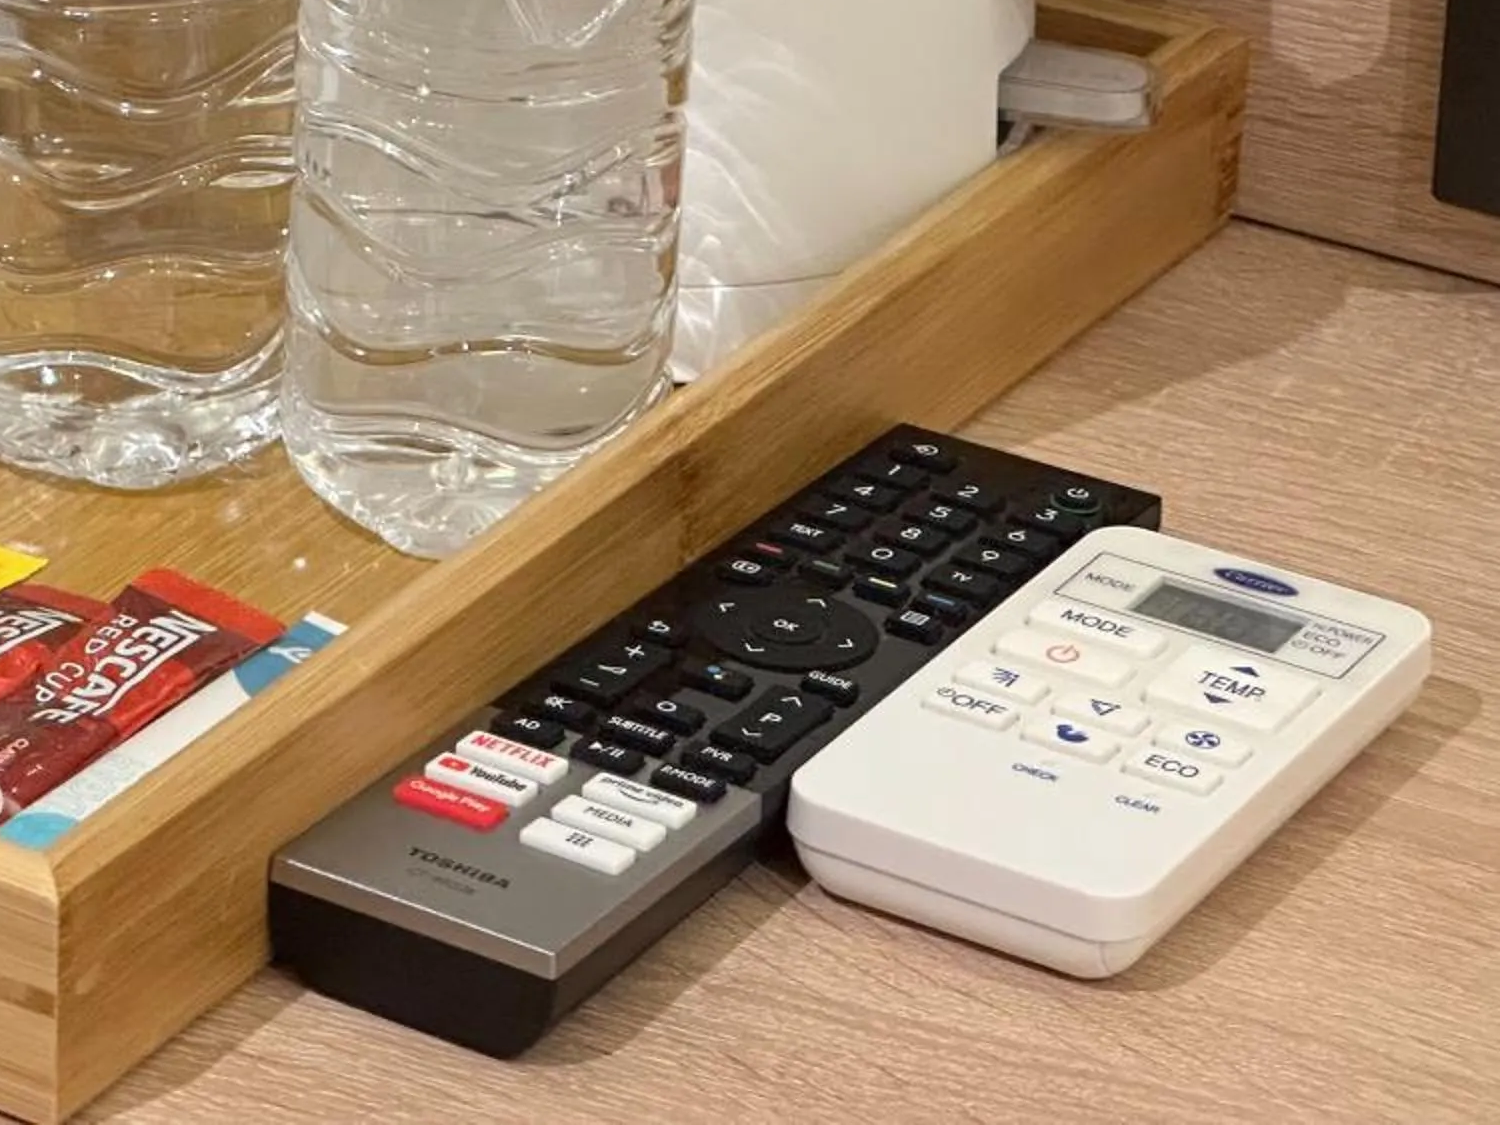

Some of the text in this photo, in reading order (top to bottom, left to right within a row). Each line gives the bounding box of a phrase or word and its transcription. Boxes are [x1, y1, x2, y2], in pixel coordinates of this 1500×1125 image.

[887, 464, 902, 477] 1
[853, 483, 876, 497] 4
[956, 485, 980, 499] 2
[825, 503, 848, 516] 7
[929, 506, 953, 520] 5
[1036, 508, 1059, 522] 3
[790, 523, 825, 539] TEXT
[900, 526, 923, 540] 8
[1008, 528, 1027, 543] 6
[981, 549, 1000, 563] 9
[1084, 572, 1139, 593] MODE
[772, 618, 800, 633] OK
[1061, 608, 1135, 639] MODE
[83, 613, 140, 655] RED
[1302, 630, 1341, 647] ECO
[1309, 644, 1346, 659] OFF
[34, 661, 85, 703] CUP
[808, 669, 853, 691] GUIDE
[950, 693, 1010, 715] OFF
[513, 717, 541, 731] AD
[759, 712, 784, 725] P
[606, 715, 669, 740] SUBTITLE
[470, 733, 557, 769] NETFLIX
[700, 746, 733, 762] PVR
[1010, 762, 1060, 783] CHECK
[1143, 753, 1200, 779] ECO
[469, 765, 528, 792] YouTube
[1114, 793, 1162, 815] CLEAR
[584, 805, 633, 828] MEDIA
[408, 846, 510, 889] TOSHIBA
